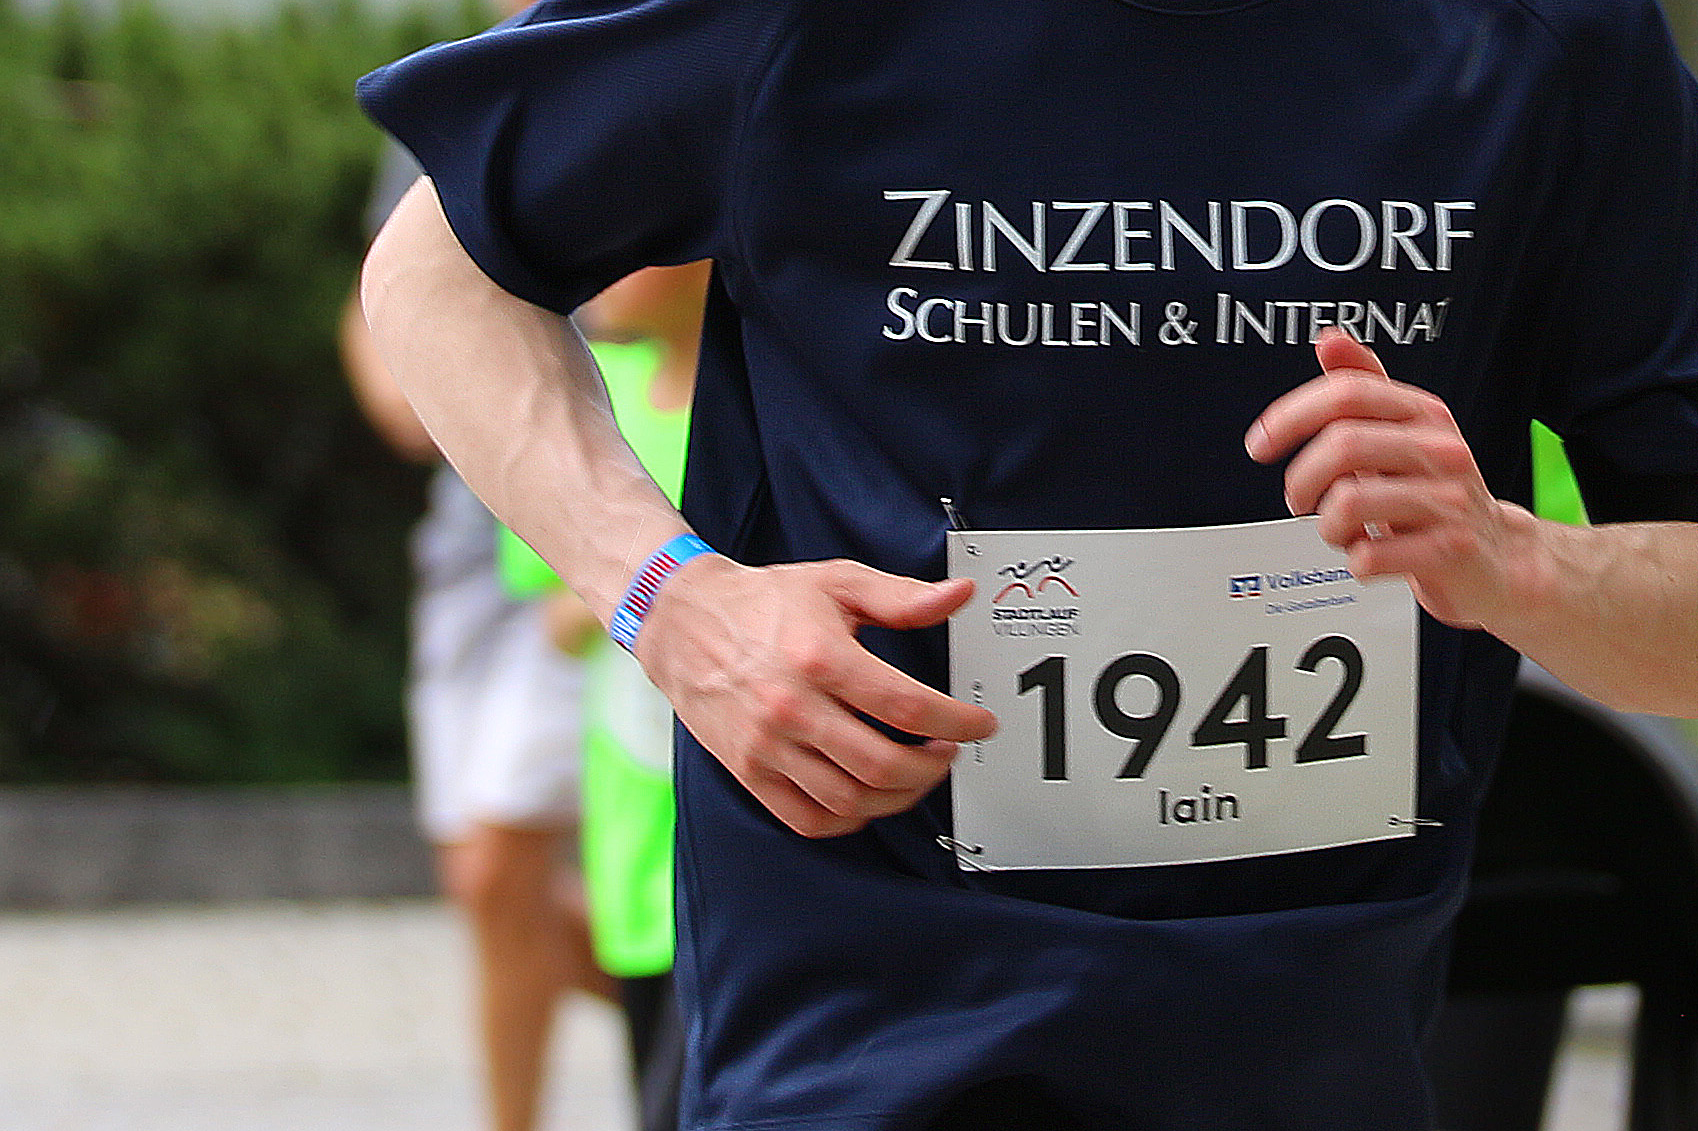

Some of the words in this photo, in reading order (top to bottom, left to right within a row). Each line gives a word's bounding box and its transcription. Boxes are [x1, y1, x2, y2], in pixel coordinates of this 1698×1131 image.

[883, 189, 1476, 272] ZINZENDORF
[882, 287, 1141, 346] SCHULEN
[1158, 302, 1198, 345] &
[1016, 634, 1370, 782] 1942
